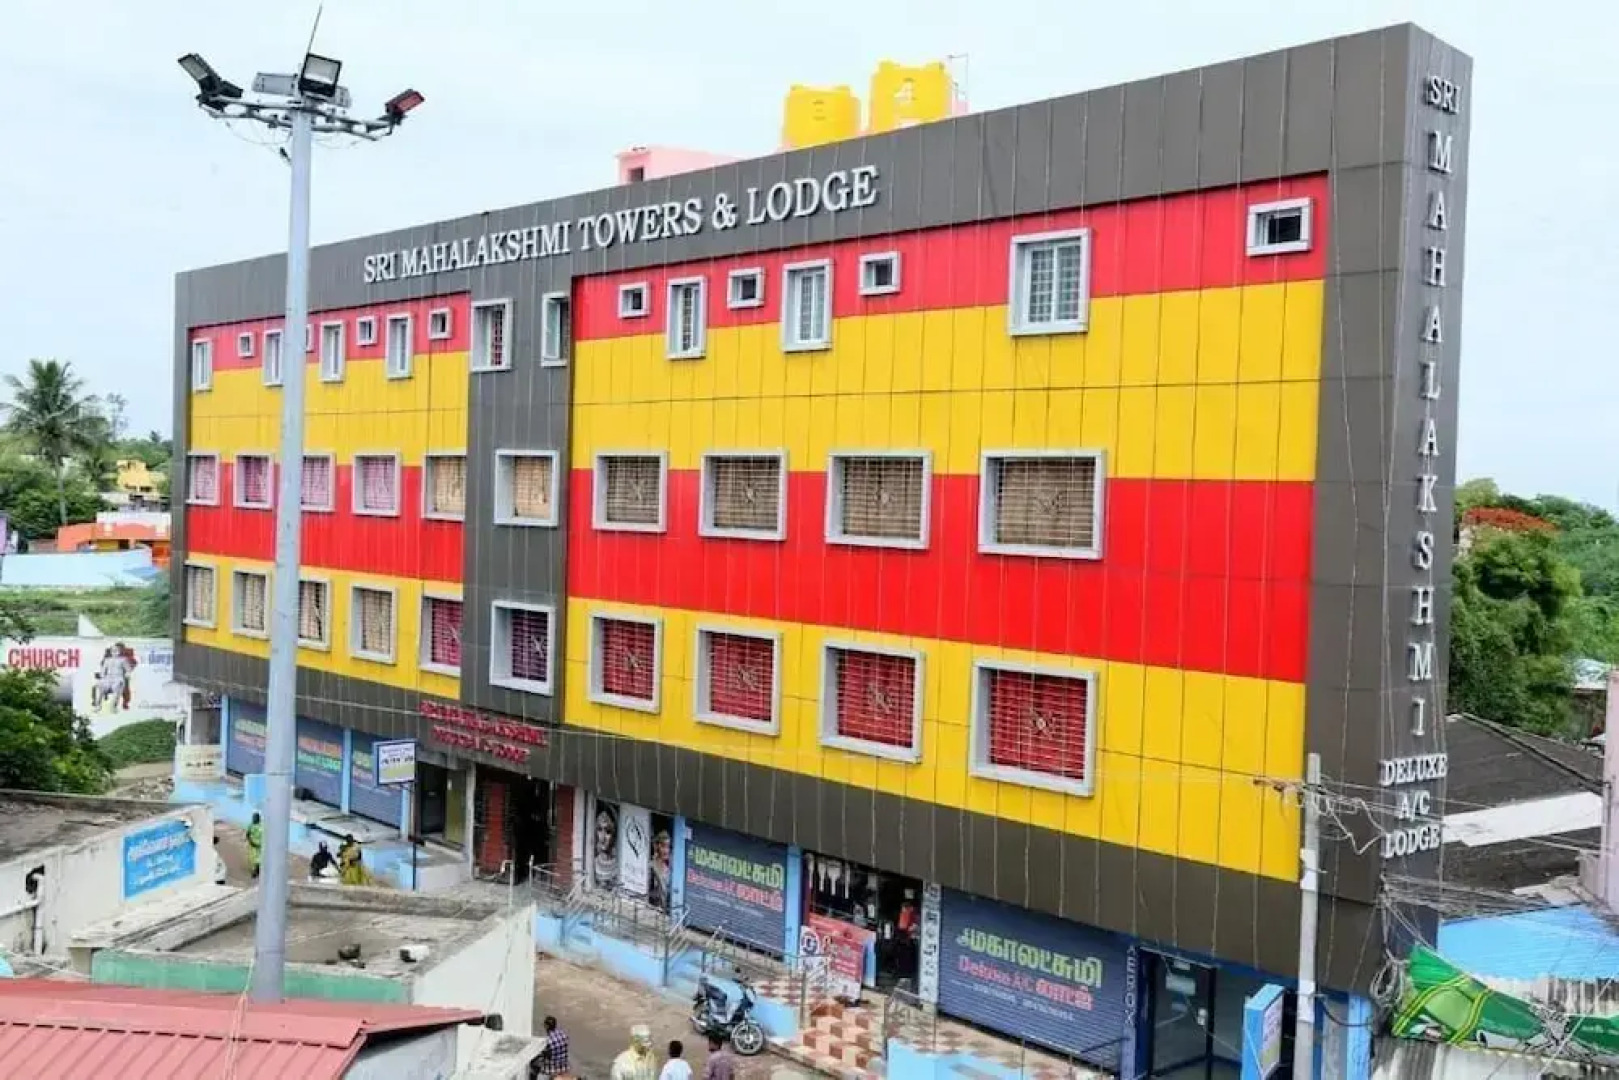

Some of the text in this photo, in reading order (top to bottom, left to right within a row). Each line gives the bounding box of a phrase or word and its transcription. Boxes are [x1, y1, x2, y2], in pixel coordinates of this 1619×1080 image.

[1427, 75, 1461, 114] SRI
[362, 164, 879, 284] SRI MAHALAKSHMI TOWERS & LODGE
[7, 647, 82, 668] CHURCH
[1379, 753, 1448, 787] DELUXE
[1398, 789, 1431, 822] A/C
[1379, 823, 1441, 859] LODGE
